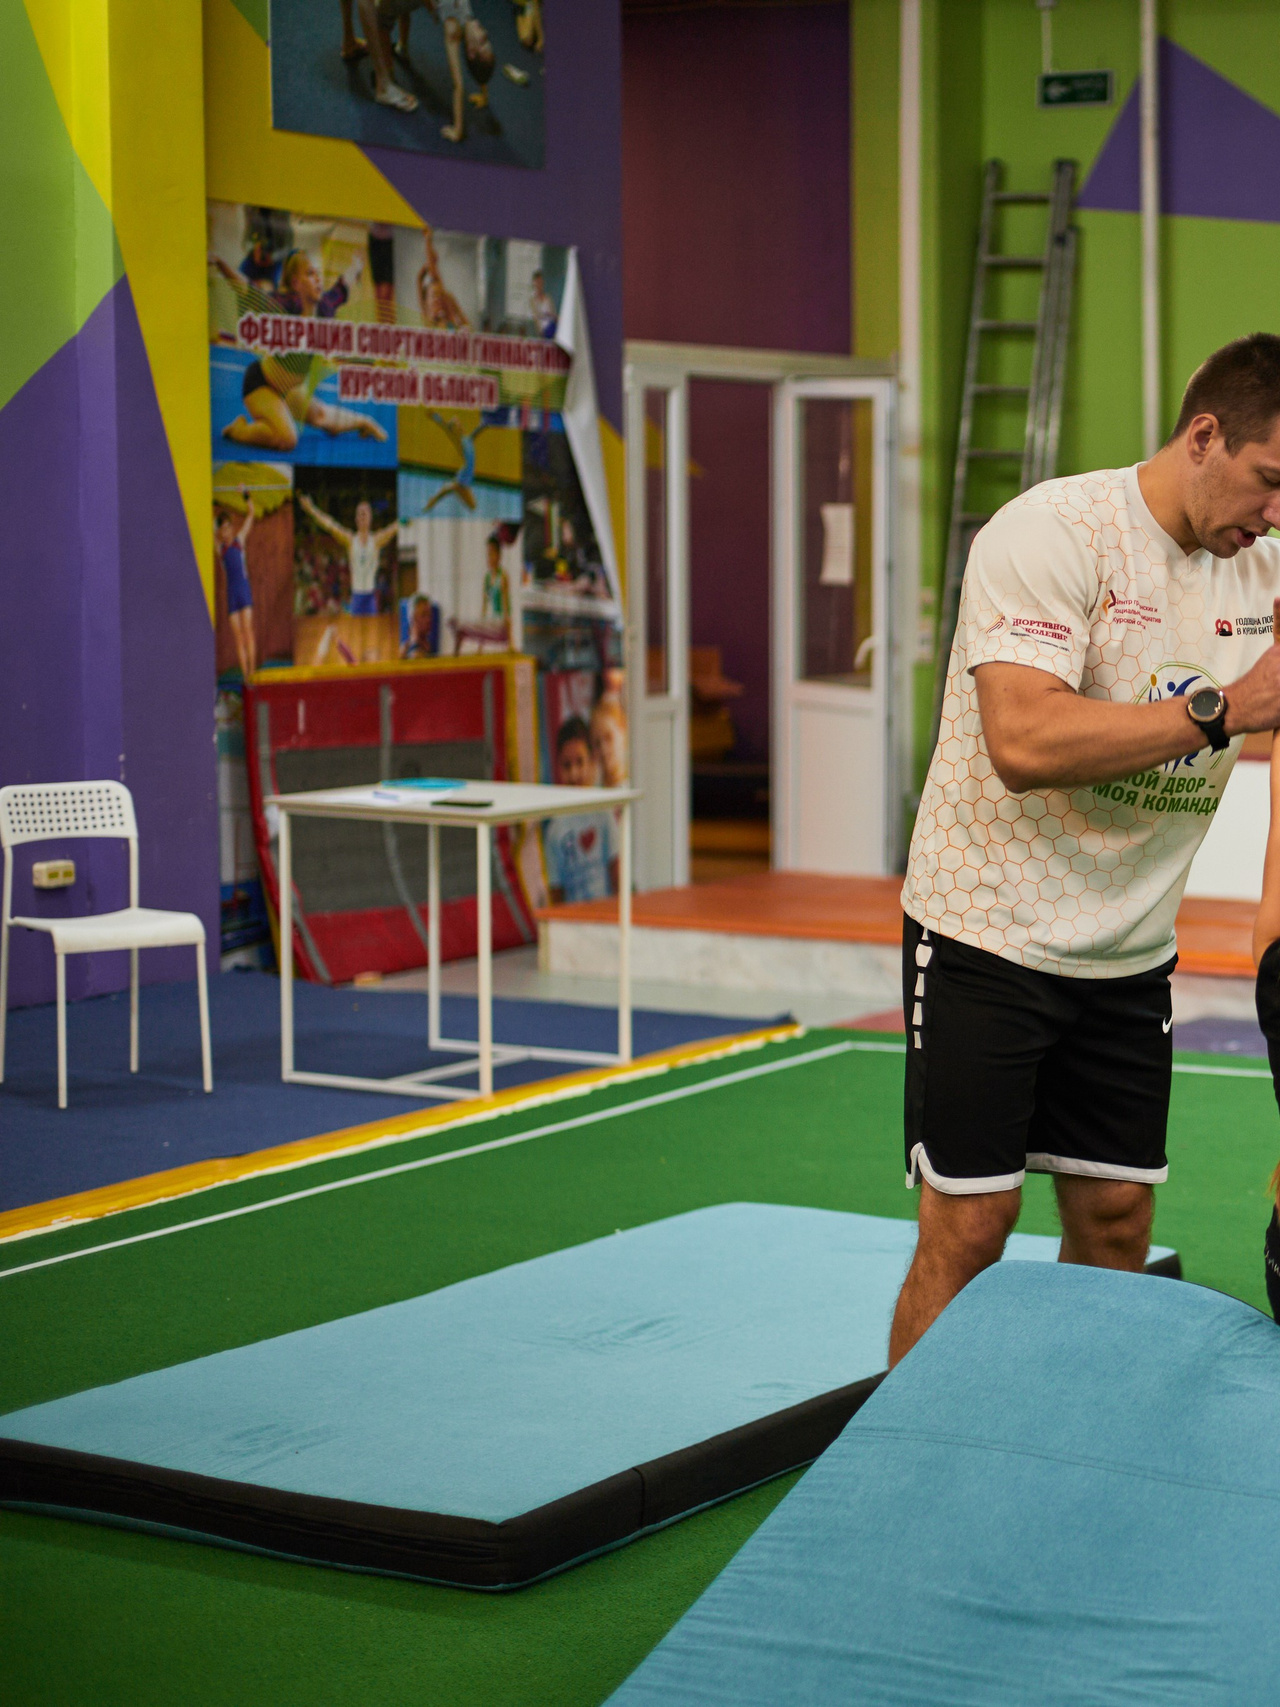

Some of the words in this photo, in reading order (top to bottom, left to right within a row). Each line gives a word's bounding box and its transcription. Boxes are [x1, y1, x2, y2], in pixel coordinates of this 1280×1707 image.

[240, 315, 354, 354] ФЕДЕРАЦИЯ
[357, 325, 469, 361] СПОРТИВНОЙ
[340, 367, 418, 401] КУРСКОЙ
[423, 373, 496, 405] ОБЛАСТИ
[1092, 783, 1139, 807] МОЯ
[1142, 794, 1219, 816] КОМАНДА
[1124, 770, 1160, 790] ОЙ
[1160, 776, 1207, 796] ДВОР
